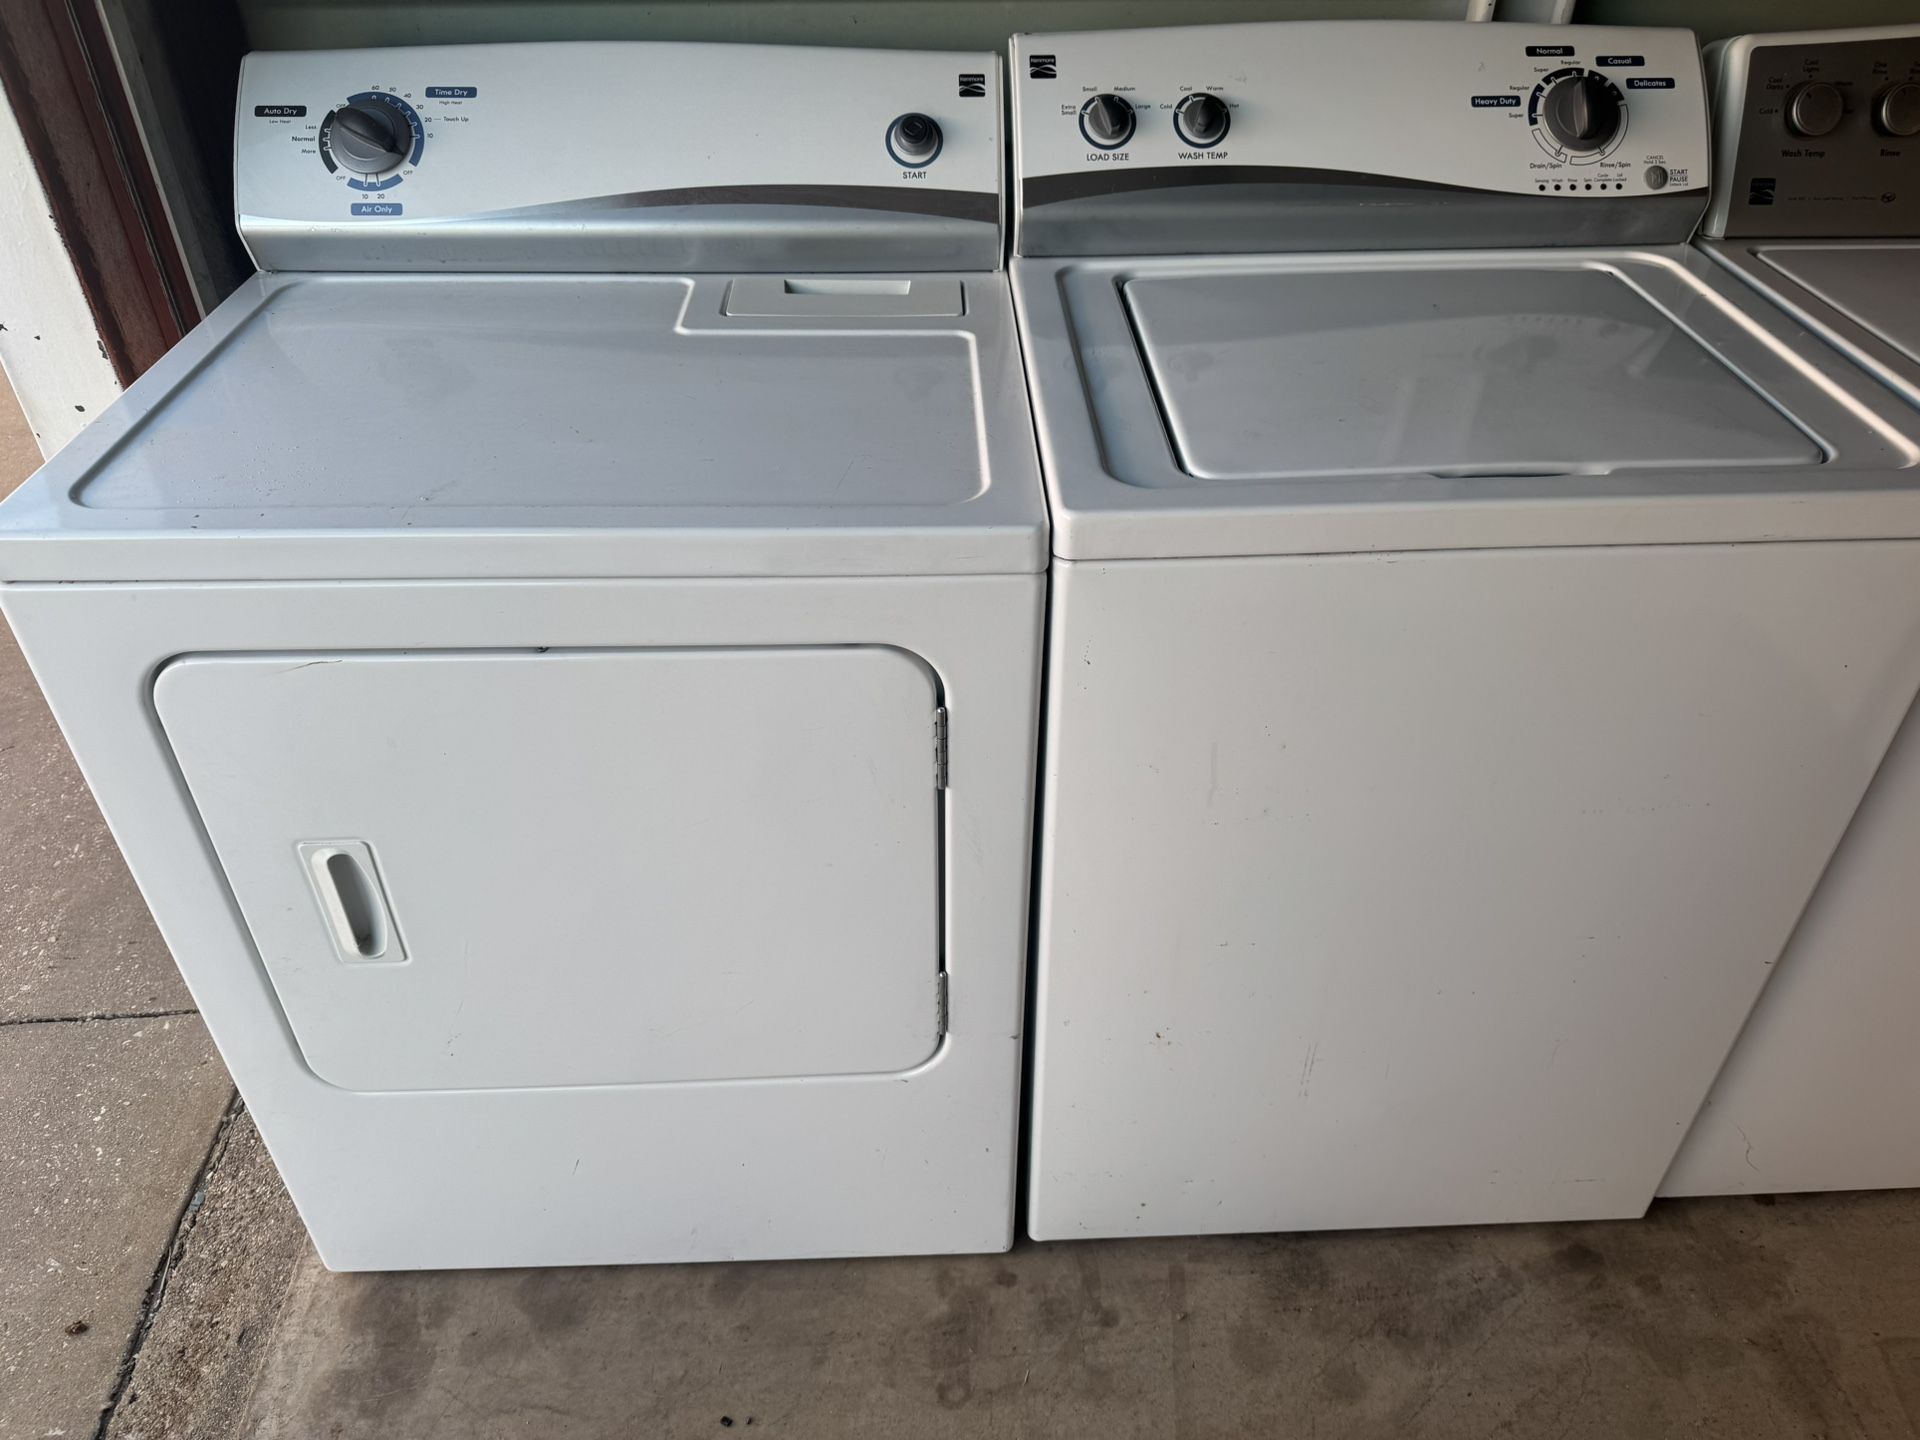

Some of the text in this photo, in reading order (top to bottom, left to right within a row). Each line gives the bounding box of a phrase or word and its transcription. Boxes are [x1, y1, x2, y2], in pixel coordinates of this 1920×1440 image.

[454, 89, 468, 97] Dry
[1805, 150, 1825, 158] Temp
[374, 206, 393, 214] Only
